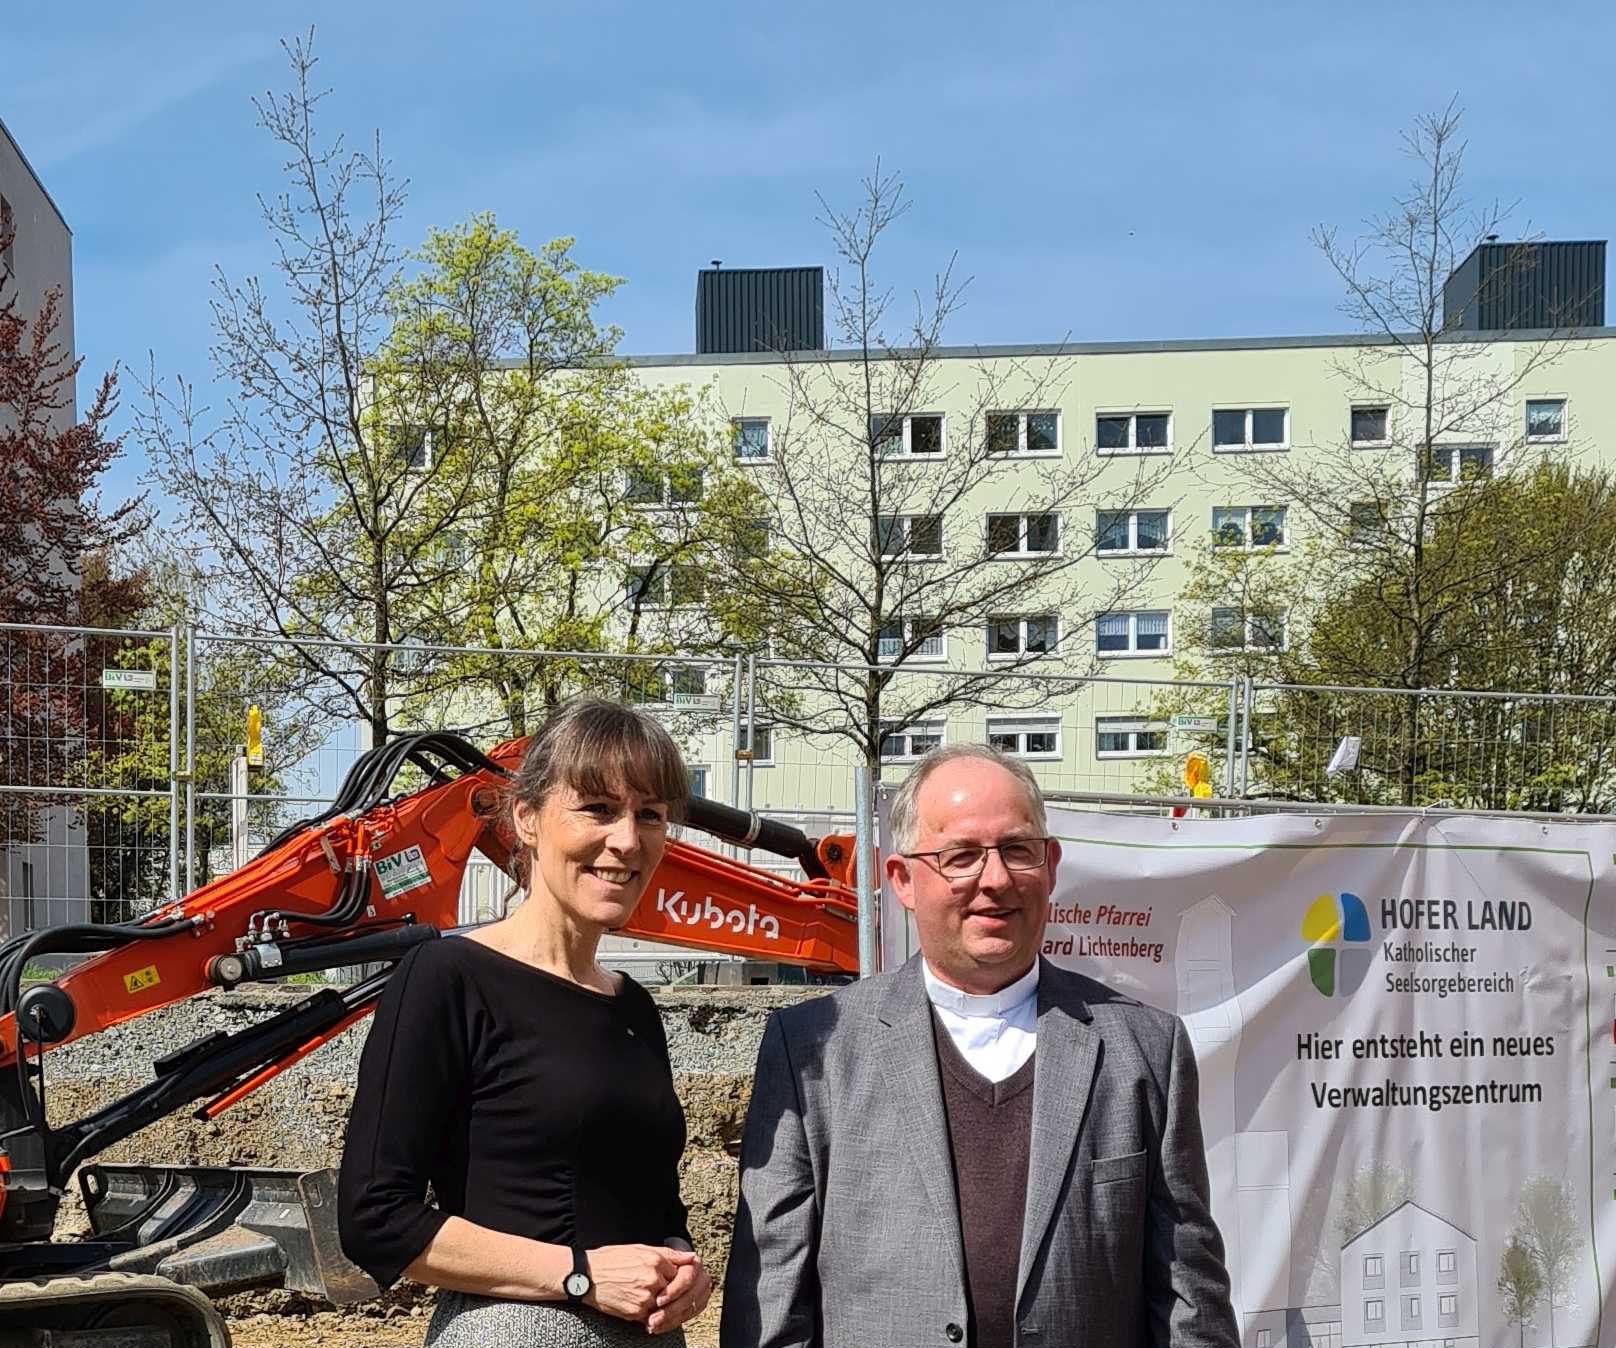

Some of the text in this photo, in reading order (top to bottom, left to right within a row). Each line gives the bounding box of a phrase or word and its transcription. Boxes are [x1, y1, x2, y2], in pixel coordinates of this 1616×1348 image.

[376, 853, 402, 875] BiV
[656, 888, 780, 939] Kubota
[1047, 902, 1152, 927] lische Pfarrei
[1381, 898, 1533, 931] HOFER LAND
[1042, 935, 1164, 963] ard Lichtenberg
[1383, 940, 1477, 963] Katholischer
[1386, 971, 1514, 998] Seelsorgebereich
[1297, 1030, 1555, 1060] Hier entsteht ein neues
[1310, 1078, 1542, 1112] Verwaltungszentrum
